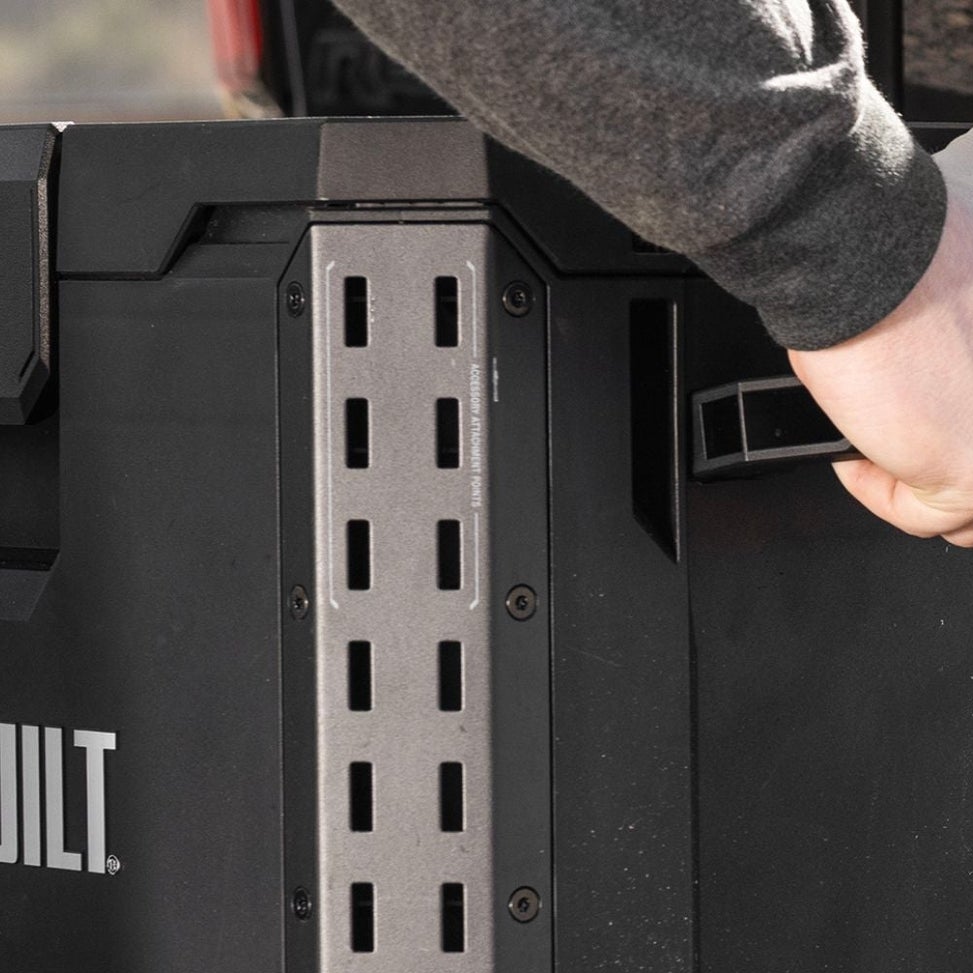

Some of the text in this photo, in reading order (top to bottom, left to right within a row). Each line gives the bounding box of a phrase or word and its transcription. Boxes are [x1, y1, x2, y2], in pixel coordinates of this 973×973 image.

[470, 363, 481, 508] ACCESSORY ATTACHMENT POINTS
